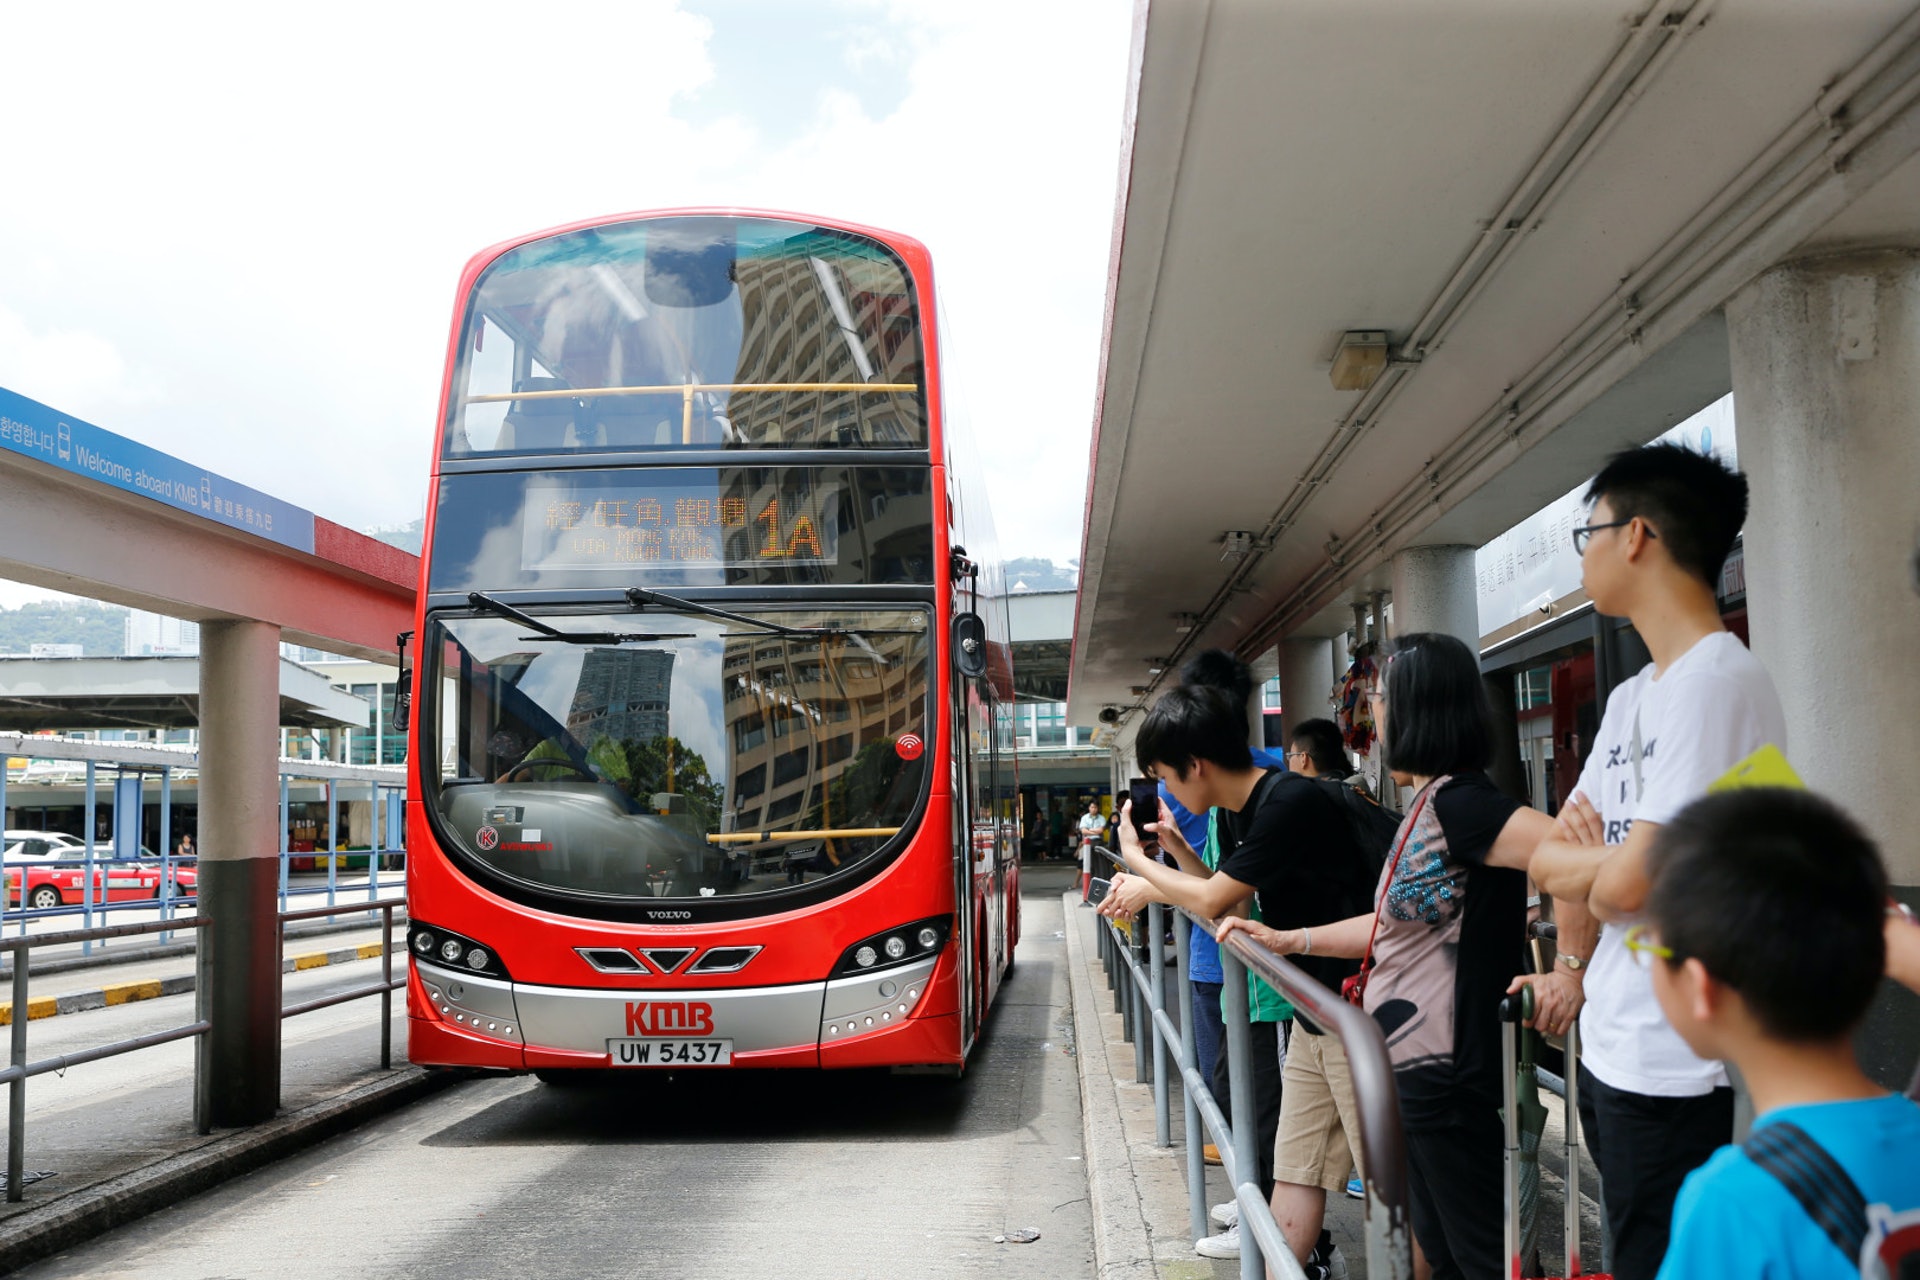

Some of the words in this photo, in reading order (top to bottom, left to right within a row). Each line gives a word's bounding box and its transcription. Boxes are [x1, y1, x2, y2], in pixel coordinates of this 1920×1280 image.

[0, 416, 54, 455] 환영합니다
[75, 443, 132, 483] Welcome
[135, 469, 172, 497] aboard
[174, 481, 198, 507] KMB
[758, 499, 822, 557] 1A
[647, 910, 692, 919] VOLVO
[625, 1002, 715, 1037] KMB
[620, 1043, 650, 1063] UW
[660, 1042, 723, 1063] 5437
